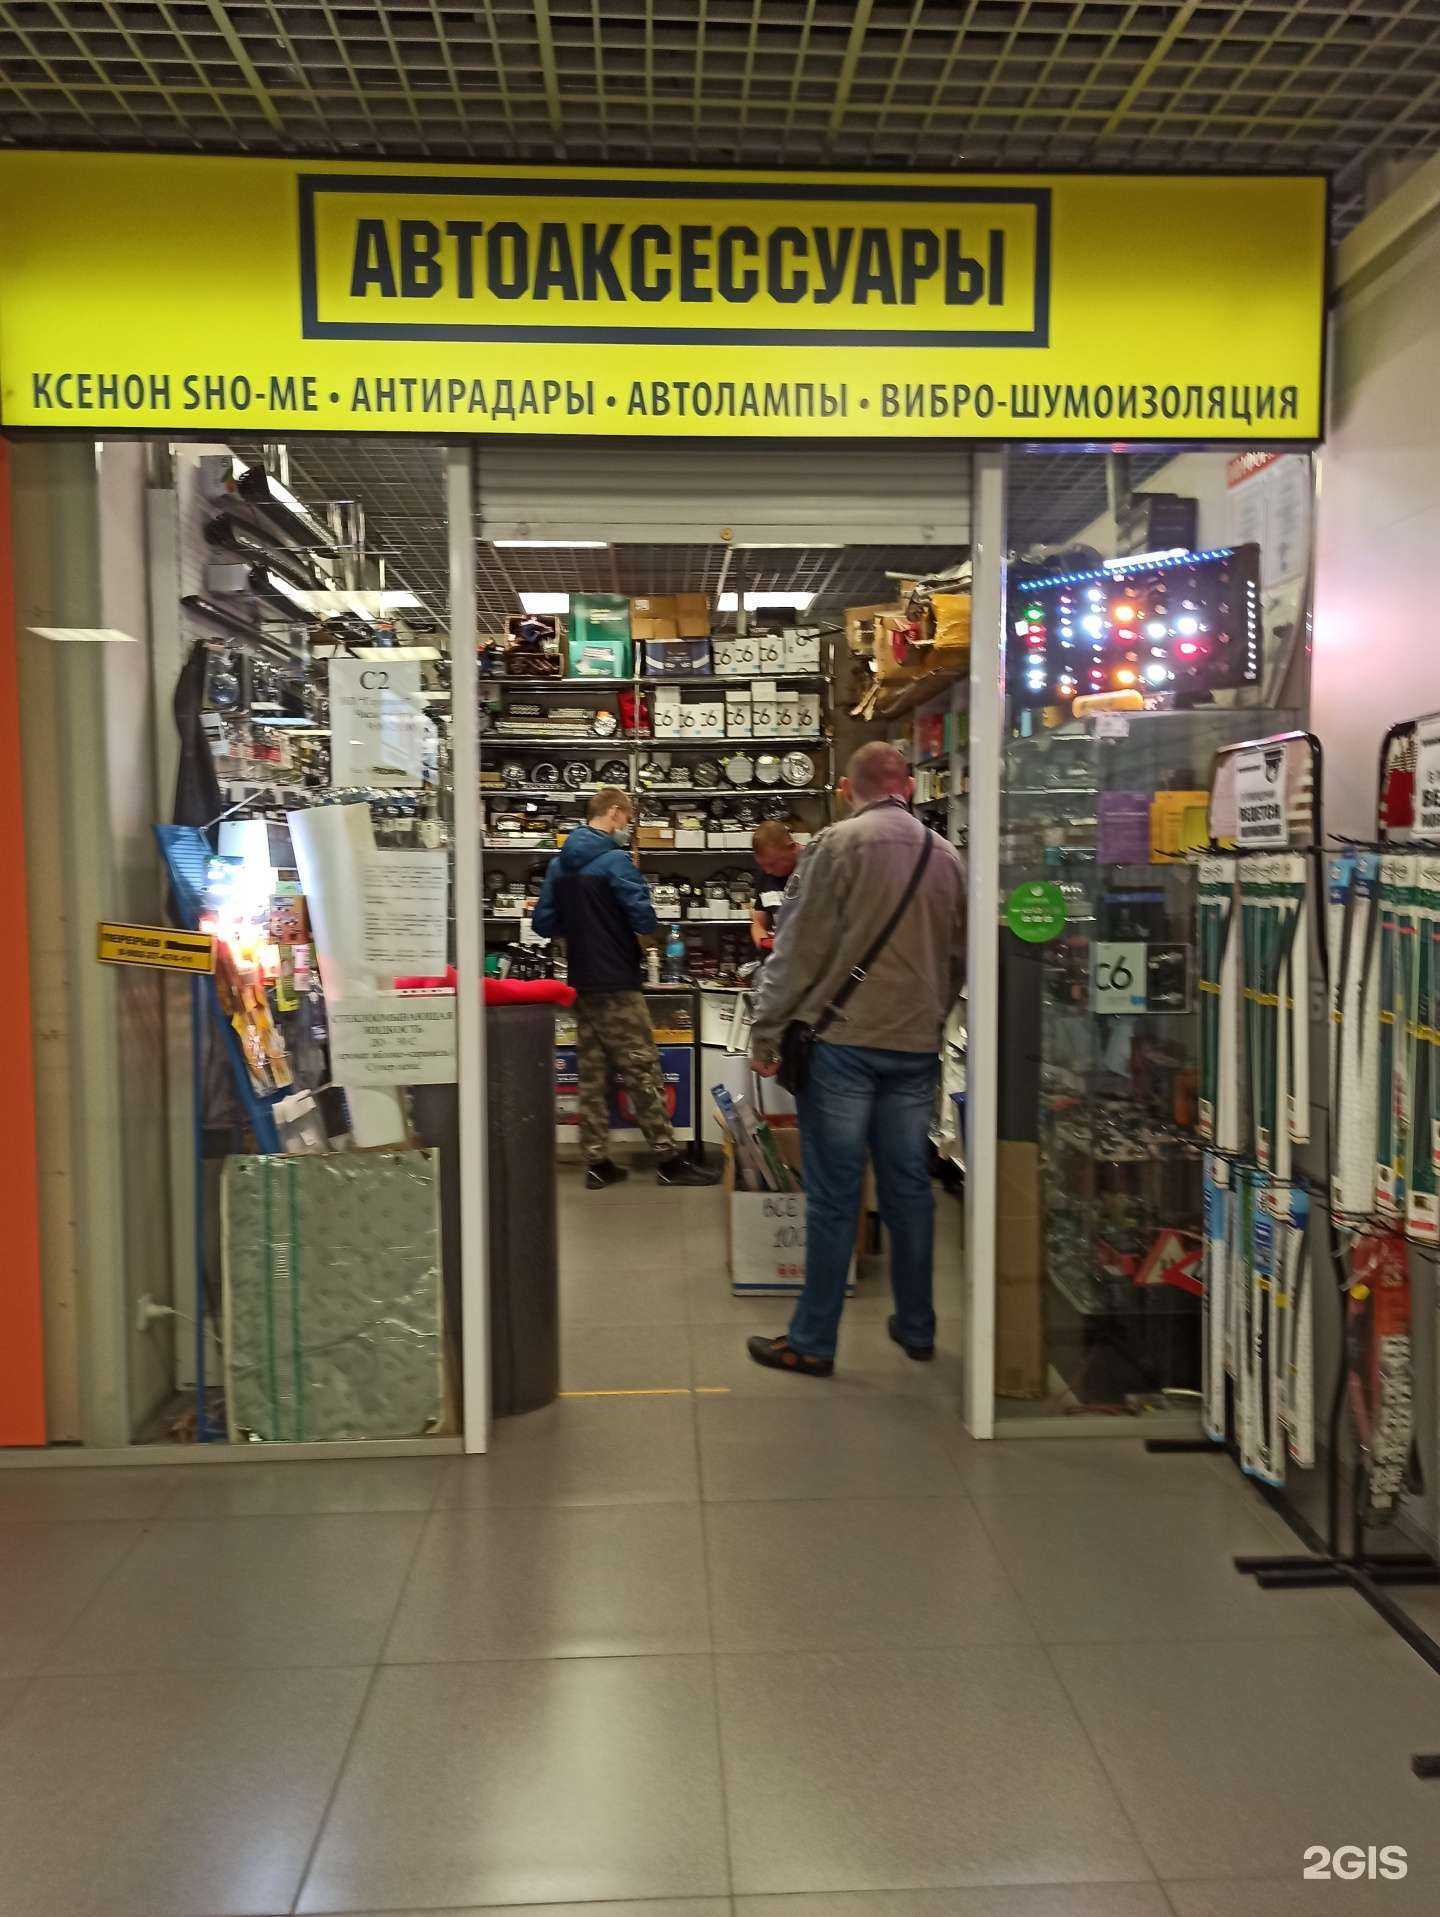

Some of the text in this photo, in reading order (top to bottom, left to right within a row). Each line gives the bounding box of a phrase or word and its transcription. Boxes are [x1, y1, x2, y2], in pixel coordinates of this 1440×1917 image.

[350, 218, 1004, 306] АВТОАКСЕССУАРЫ
[32, 373, 1298, 425] КСЕНОН SHO-ME АНТИРАДАРЫ АВТОЛАМПЫ ВИБРО-ШУМОИЗОЛЯЦИЯ
